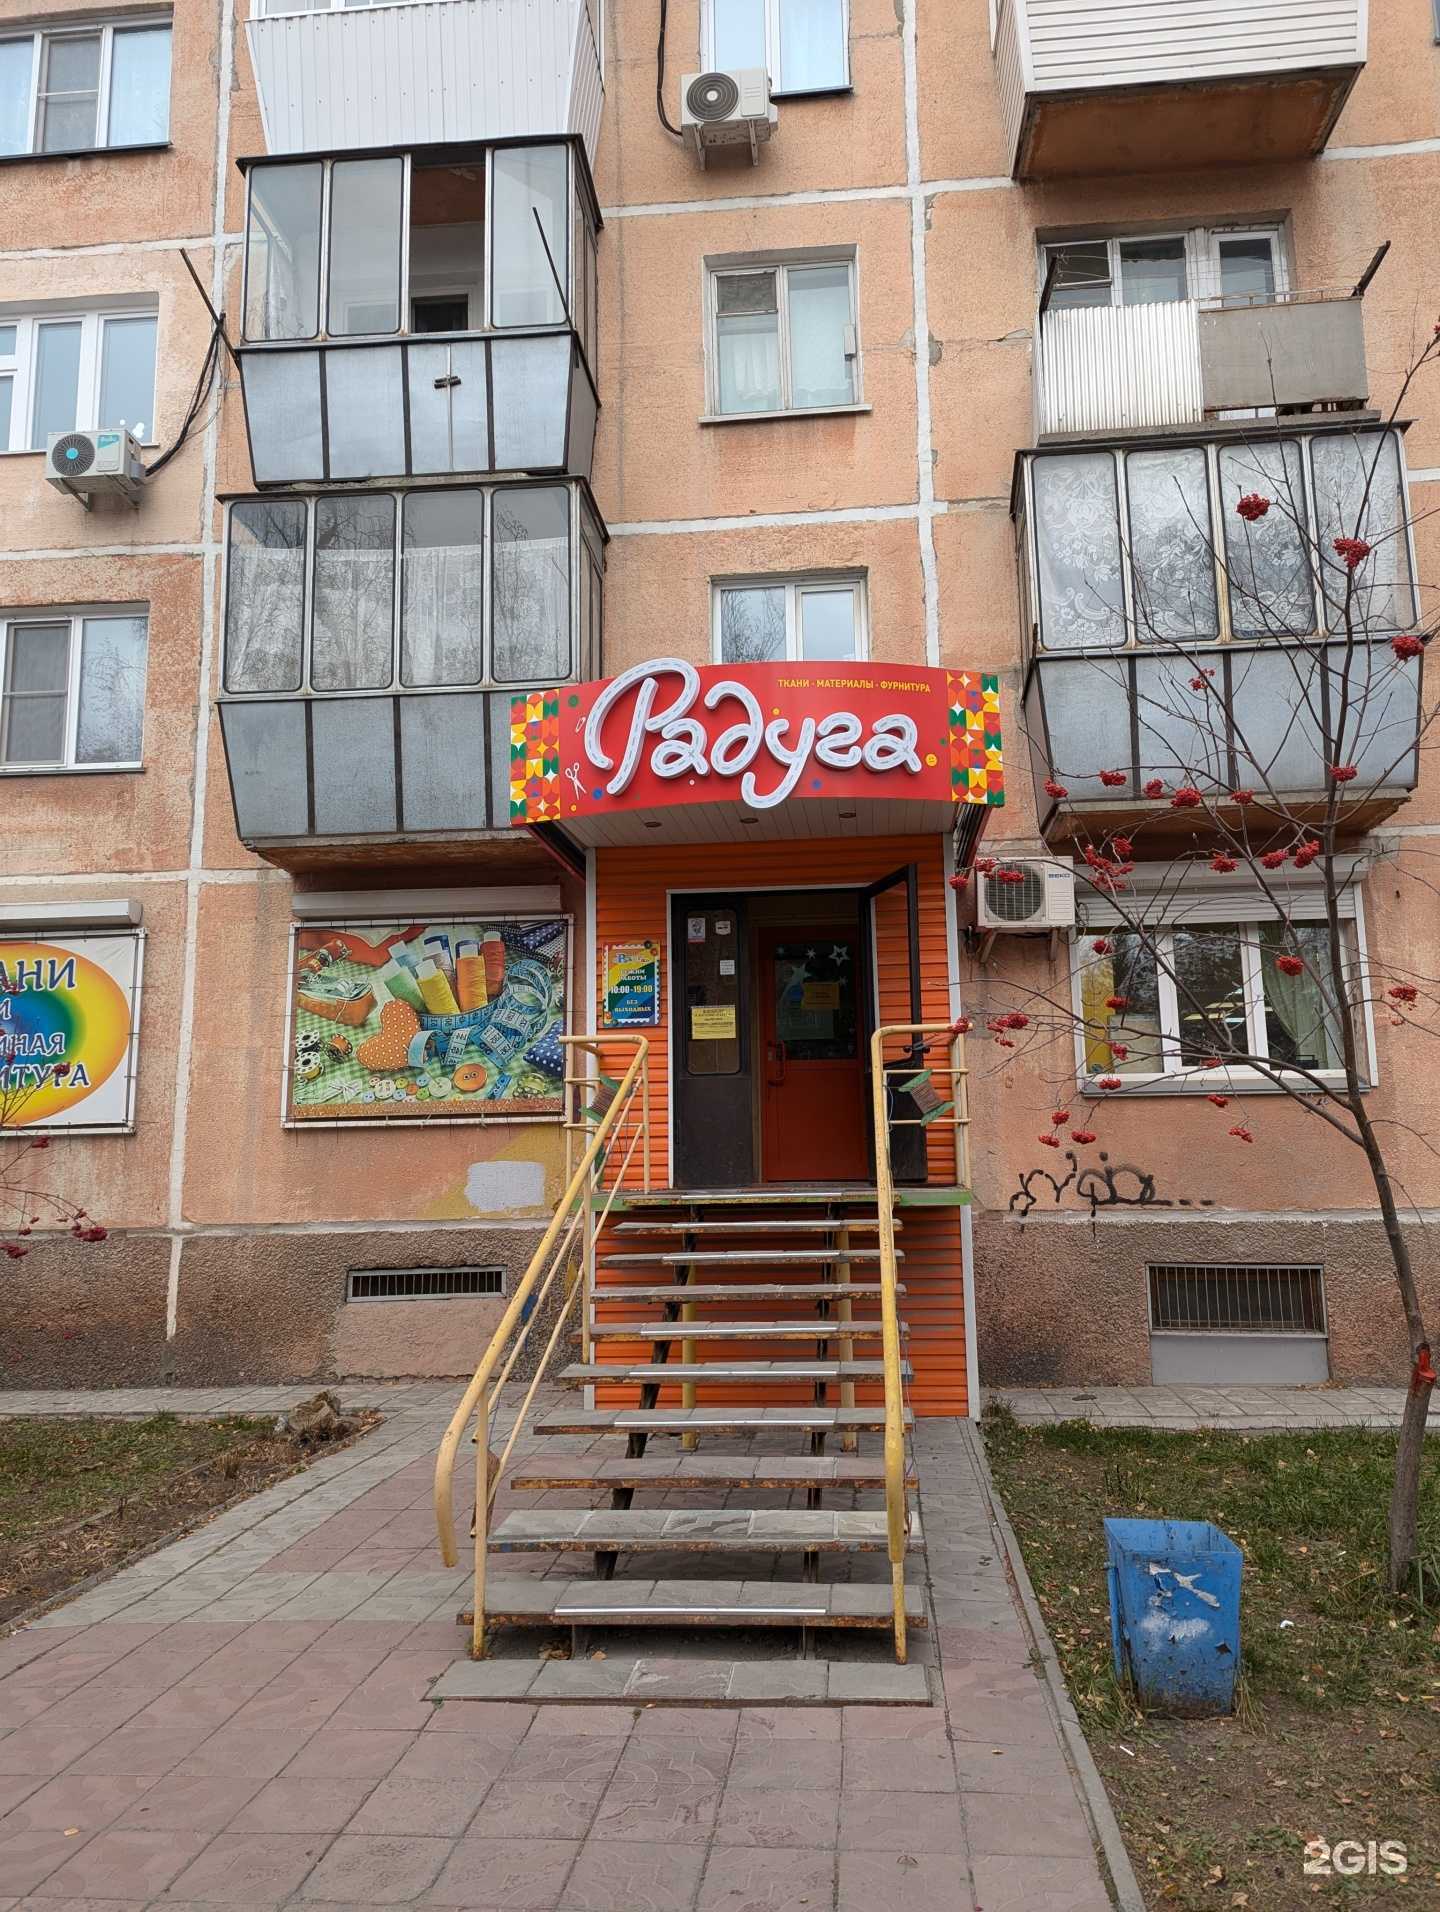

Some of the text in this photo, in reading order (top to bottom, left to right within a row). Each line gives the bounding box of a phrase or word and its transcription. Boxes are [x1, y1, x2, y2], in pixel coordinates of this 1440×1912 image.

[777, 679, 931, 693] ТКАНИ МАТЕРИАЛЫ ФУРНИТУРА
[583, 657, 923, 808] Радуга
[610, 985, 630, 994] 10:00
